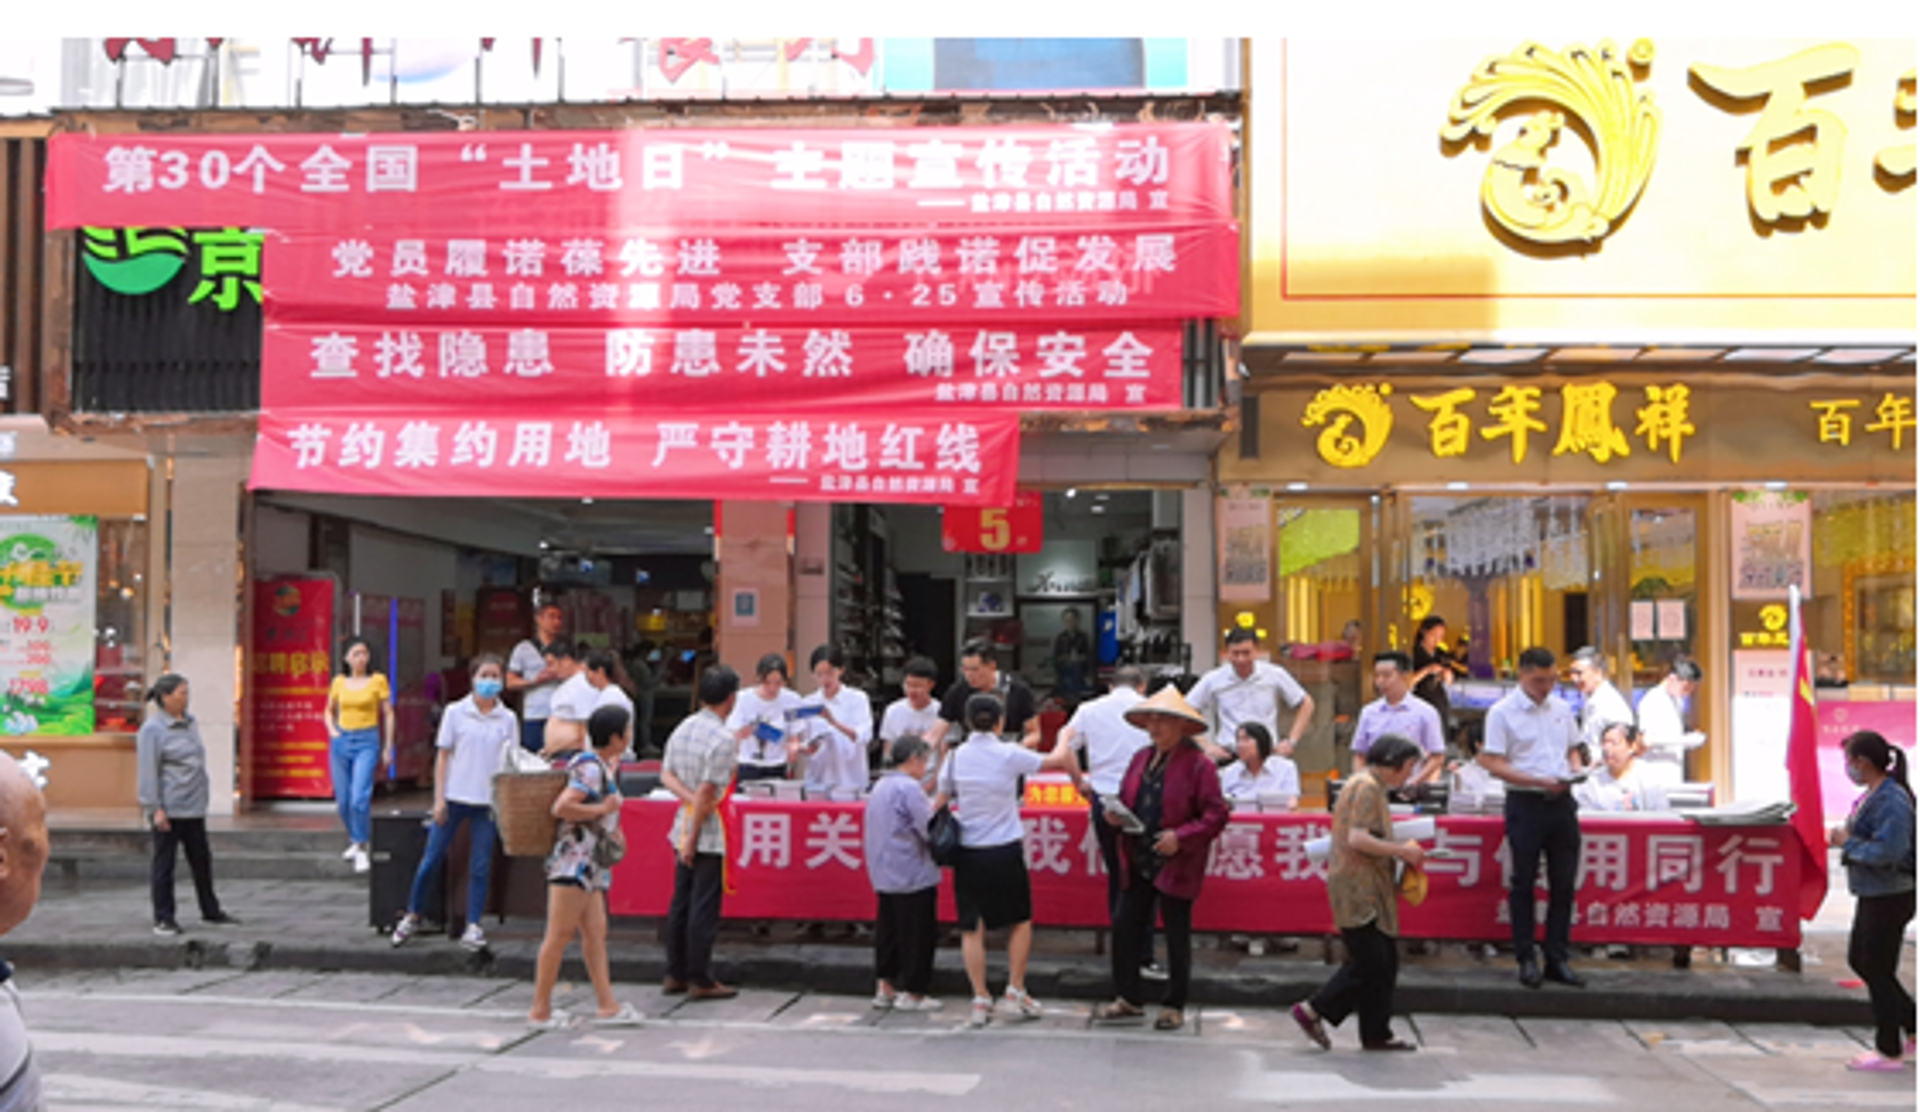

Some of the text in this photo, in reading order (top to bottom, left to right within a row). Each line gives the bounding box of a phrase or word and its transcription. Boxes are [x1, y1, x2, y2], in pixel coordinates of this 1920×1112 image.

[187, 227, 263, 311] 京
[331, 234, 1177, 278] 党员履诺葆先进 支部践诺促发展
[309, 329, 1154, 378] 查找隐患 防患未然 确保安全
[286, 420, 982, 474] 节约集约用地 严守耕地红线
